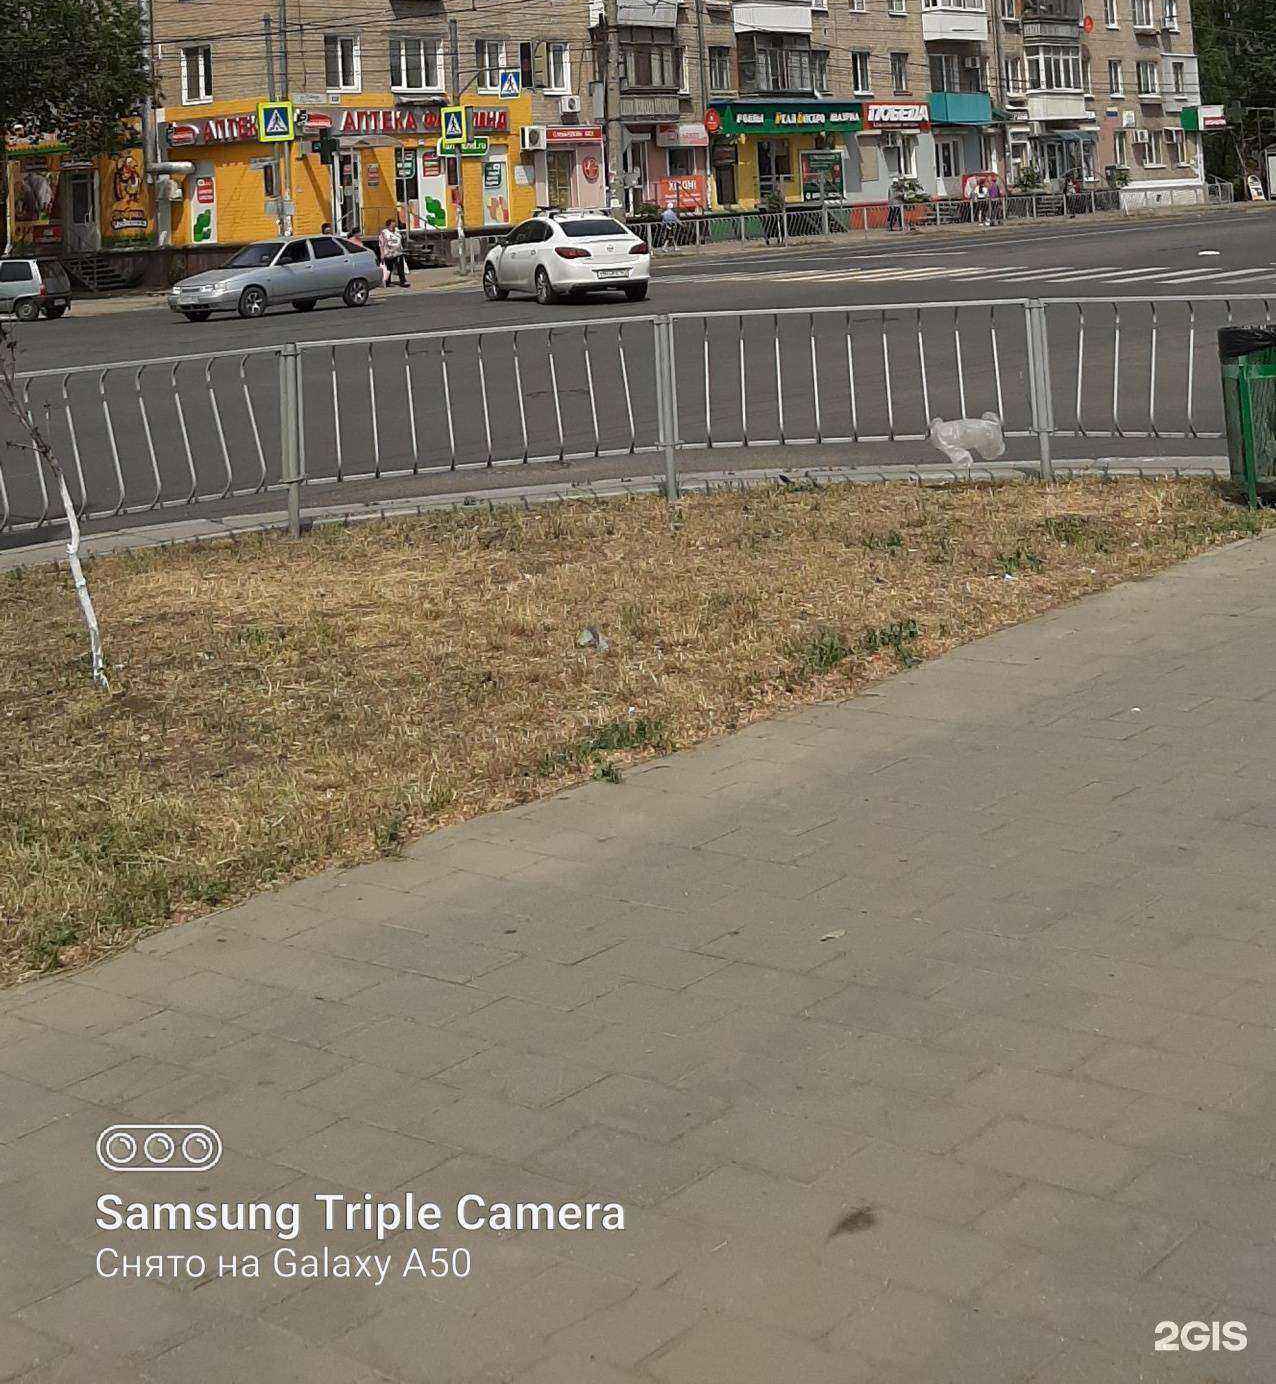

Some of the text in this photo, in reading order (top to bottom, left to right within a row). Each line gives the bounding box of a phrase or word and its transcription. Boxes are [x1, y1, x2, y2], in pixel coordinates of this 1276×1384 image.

[340, 110, 417, 135] АПТЕКА
[867, 105, 930, 122] ПОБЕДА
[204, 115, 258, 144] АПТЕК
